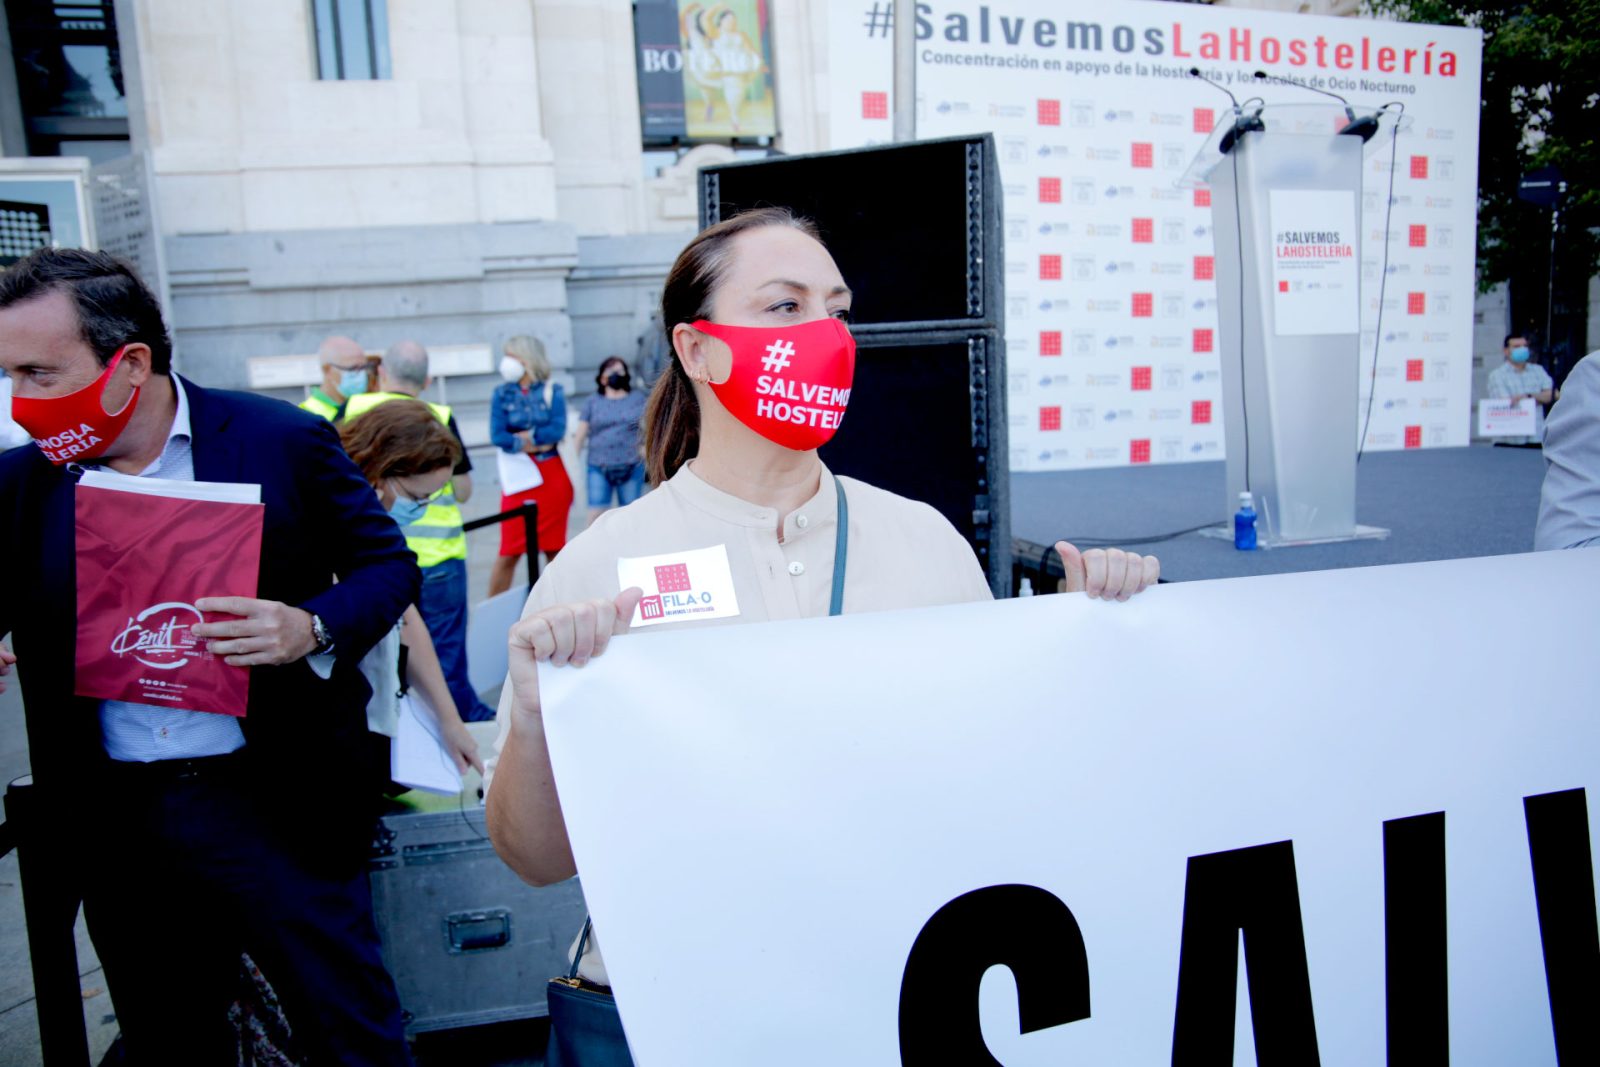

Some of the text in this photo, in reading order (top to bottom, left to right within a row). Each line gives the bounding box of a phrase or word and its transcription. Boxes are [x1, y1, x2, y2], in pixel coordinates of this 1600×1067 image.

[864, 2, 1457, 77] #SalvemosLaHostelería
[921, 49, 1039, 69] Concentración
[1043, 59, 1061, 71] en
[1065, 60, 1111, 77] apoyo
[1114, 61, 1131, 75] de
[1135, 61, 1148, 76] la
[1226, 70, 1234, 85] y
[1237, 69, 1257, 84] los
[1309, 74, 1326, 88] de
[1328, 76, 1357, 91] Ocio
[1360, 79, 1416, 94] Nocturno
[1276, 244, 1353, 258] LAHOSTELERÍA
[1277, 231, 1340, 243] #SALVEMOS
[760, 339, 796, 373] #
